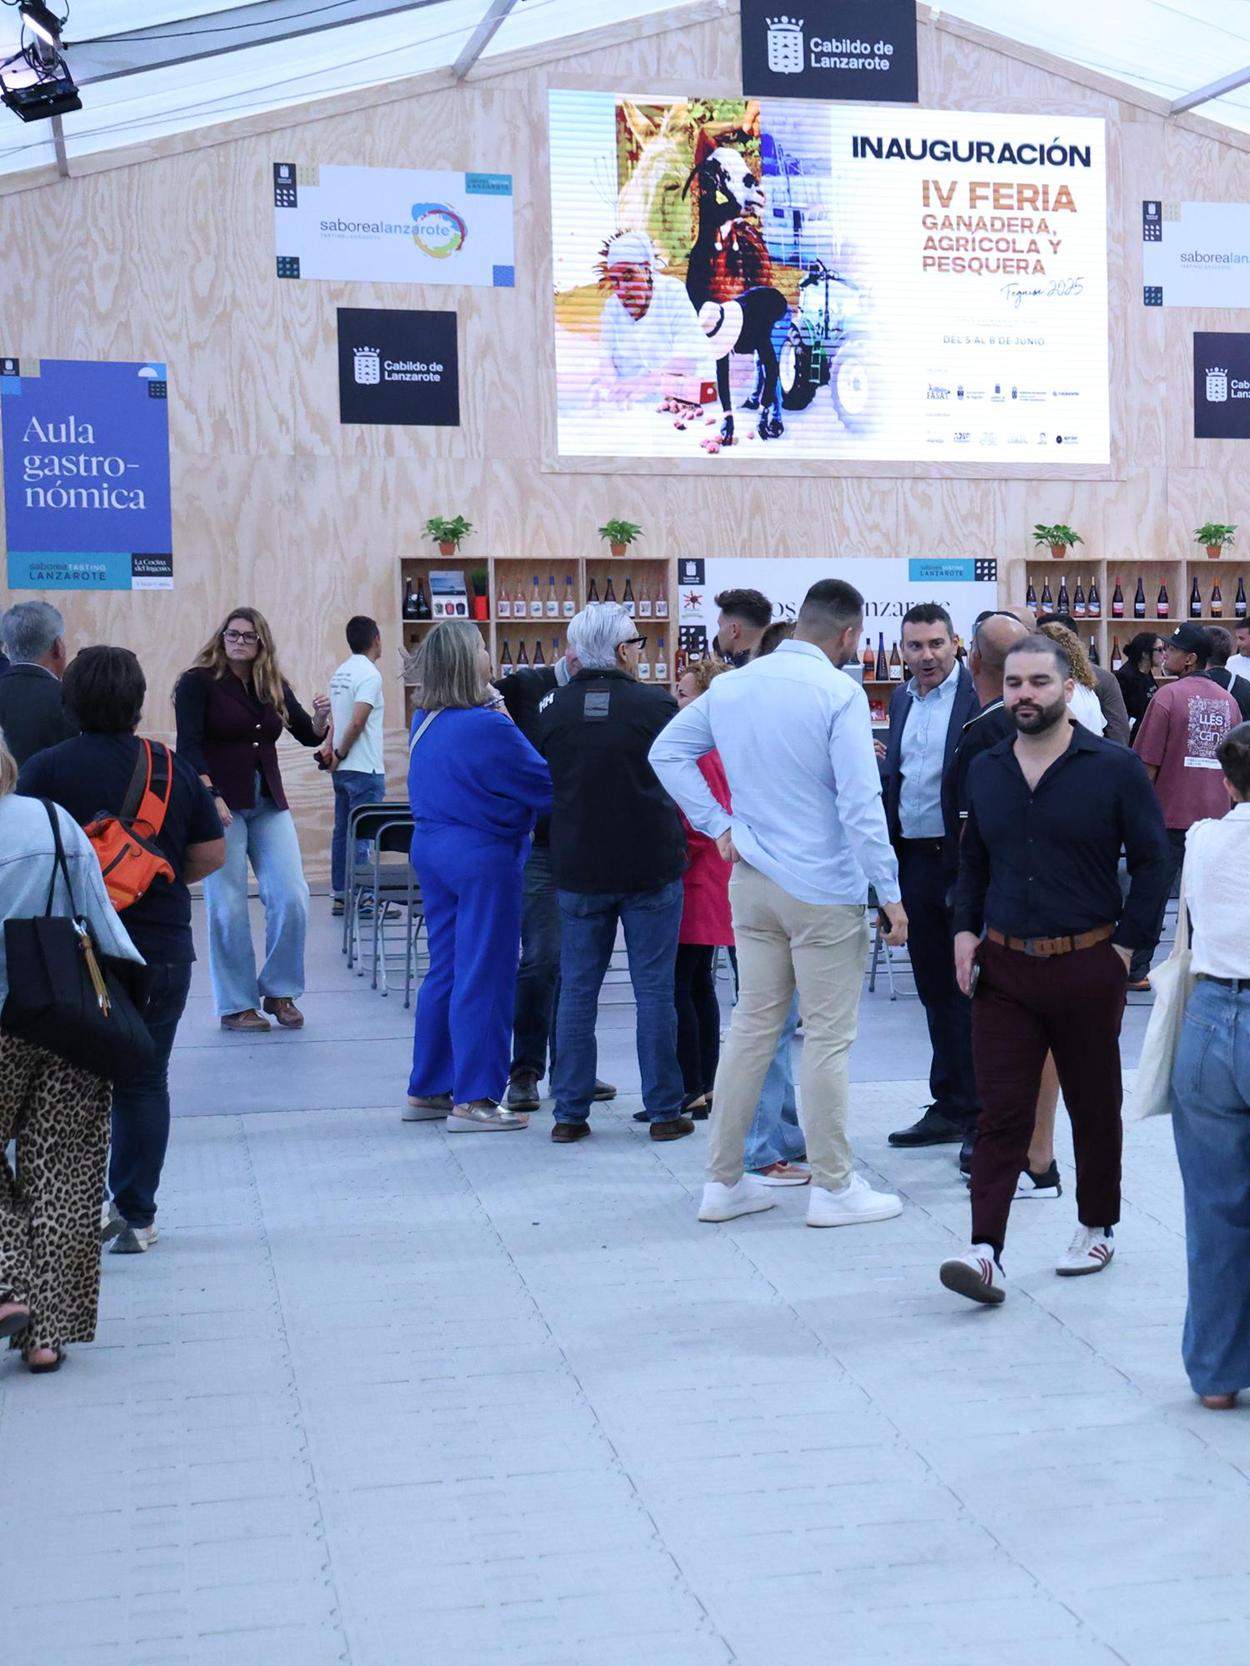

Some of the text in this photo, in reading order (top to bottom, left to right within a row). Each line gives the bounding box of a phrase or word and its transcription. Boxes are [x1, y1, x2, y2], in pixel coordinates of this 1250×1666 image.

[810, 37, 894, 56] Cabildo de
[810, 54, 890, 71] Lanzarote
[852, 135, 1092, 168] INAUGURACIÓN
[921, 179, 1078, 213] IV FERIA
[921, 213, 1058, 237] GANADERA,
[922, 234, 1063, 255] AGRÍCOLA Y
[921, 254, 1047, 277] PESQUERA
[1047, 276, 1085, 297] 2025
[943, 335, 962, 345] DEL
[974, 336, 986, 345] AL
[998, 336, 1012, 346] DE
[1014, 336, 1046, 347] JUNIO
[383, 360, 444, 373] Cabildo de
[384, 370, 442, 382] Lanzarote
[22, 414, 96, 445] Aula
[23, 453, 140, 483] gastro-
[25, 479, 147, 510] nómica
[29, 571, 107, 581] LANZAROTE
